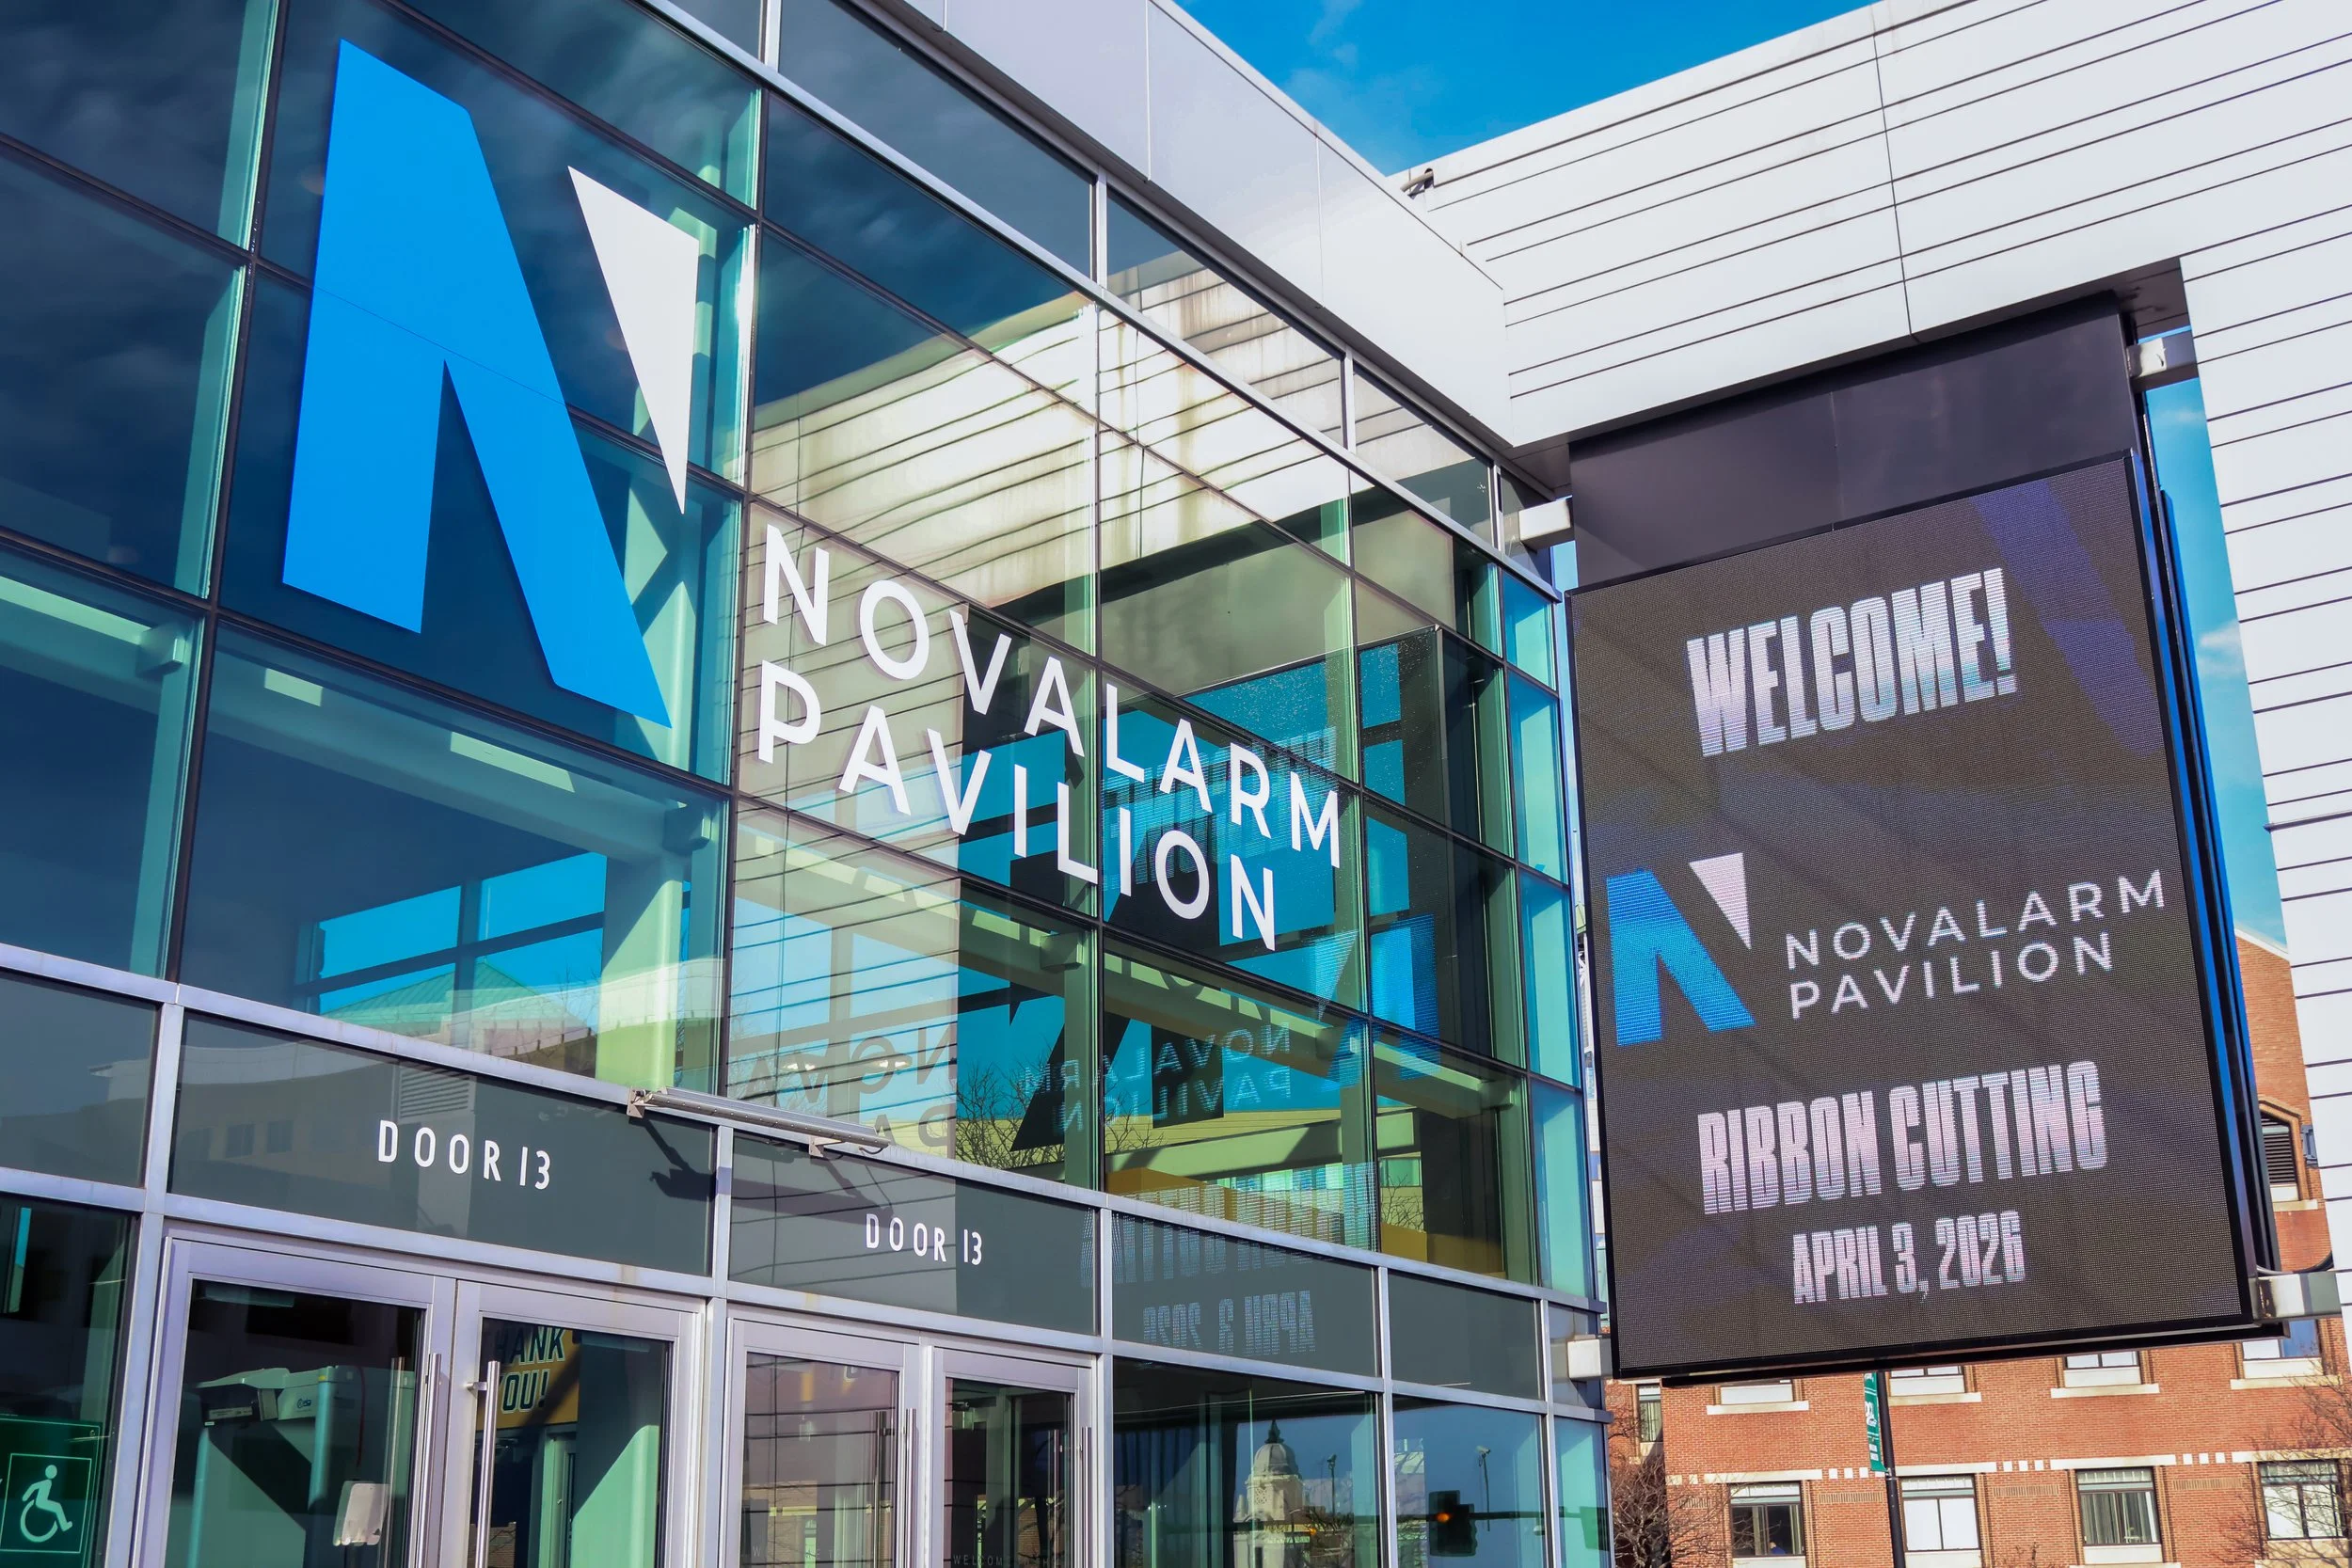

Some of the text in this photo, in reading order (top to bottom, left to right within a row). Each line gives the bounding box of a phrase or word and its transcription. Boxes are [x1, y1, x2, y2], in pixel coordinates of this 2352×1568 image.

[763, 523, 1341, 868] NOVALARM
[1686, 567, 2018, 757] WELCOME!
[757, 660, 1277, 951] PAVILION
[1787, 868, 2166, 970] NOVALARM
[1790, 931, 2114, 1020] PAVILION
[378, 1119, 551, 1190] DOOR 13
[1696, 1060, 2108, 1214] RIBBON CUTTING
[866, 1213, 982, 1265] DOOR 13
[1791, 1211, 2026, 1304] APRIL 3, 2026
[493, 1324, 566, 1367] HANK
